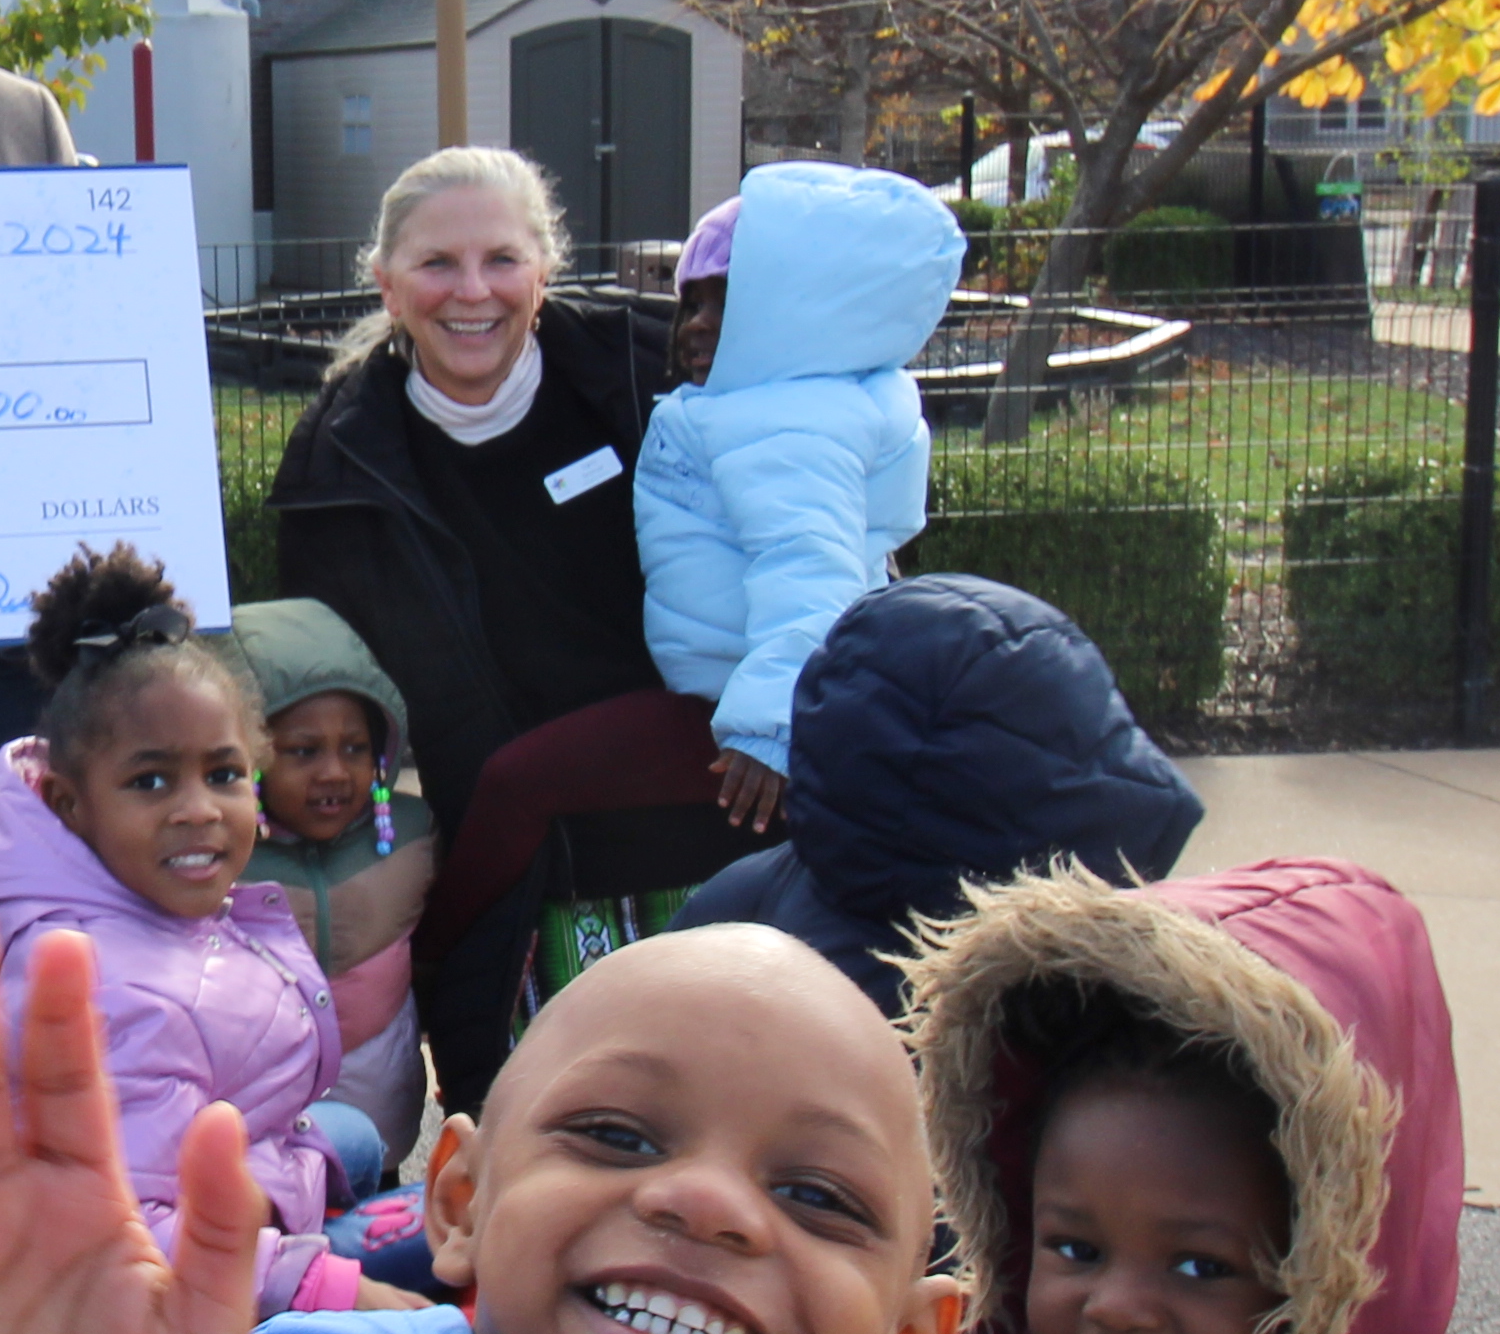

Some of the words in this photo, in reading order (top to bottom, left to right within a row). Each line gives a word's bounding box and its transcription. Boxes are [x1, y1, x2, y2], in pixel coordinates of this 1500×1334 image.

[87, 188, 132, 211] 142
[3, 221, 132, 258] 2024
[41, 495, 160, 521] DOLLARS
